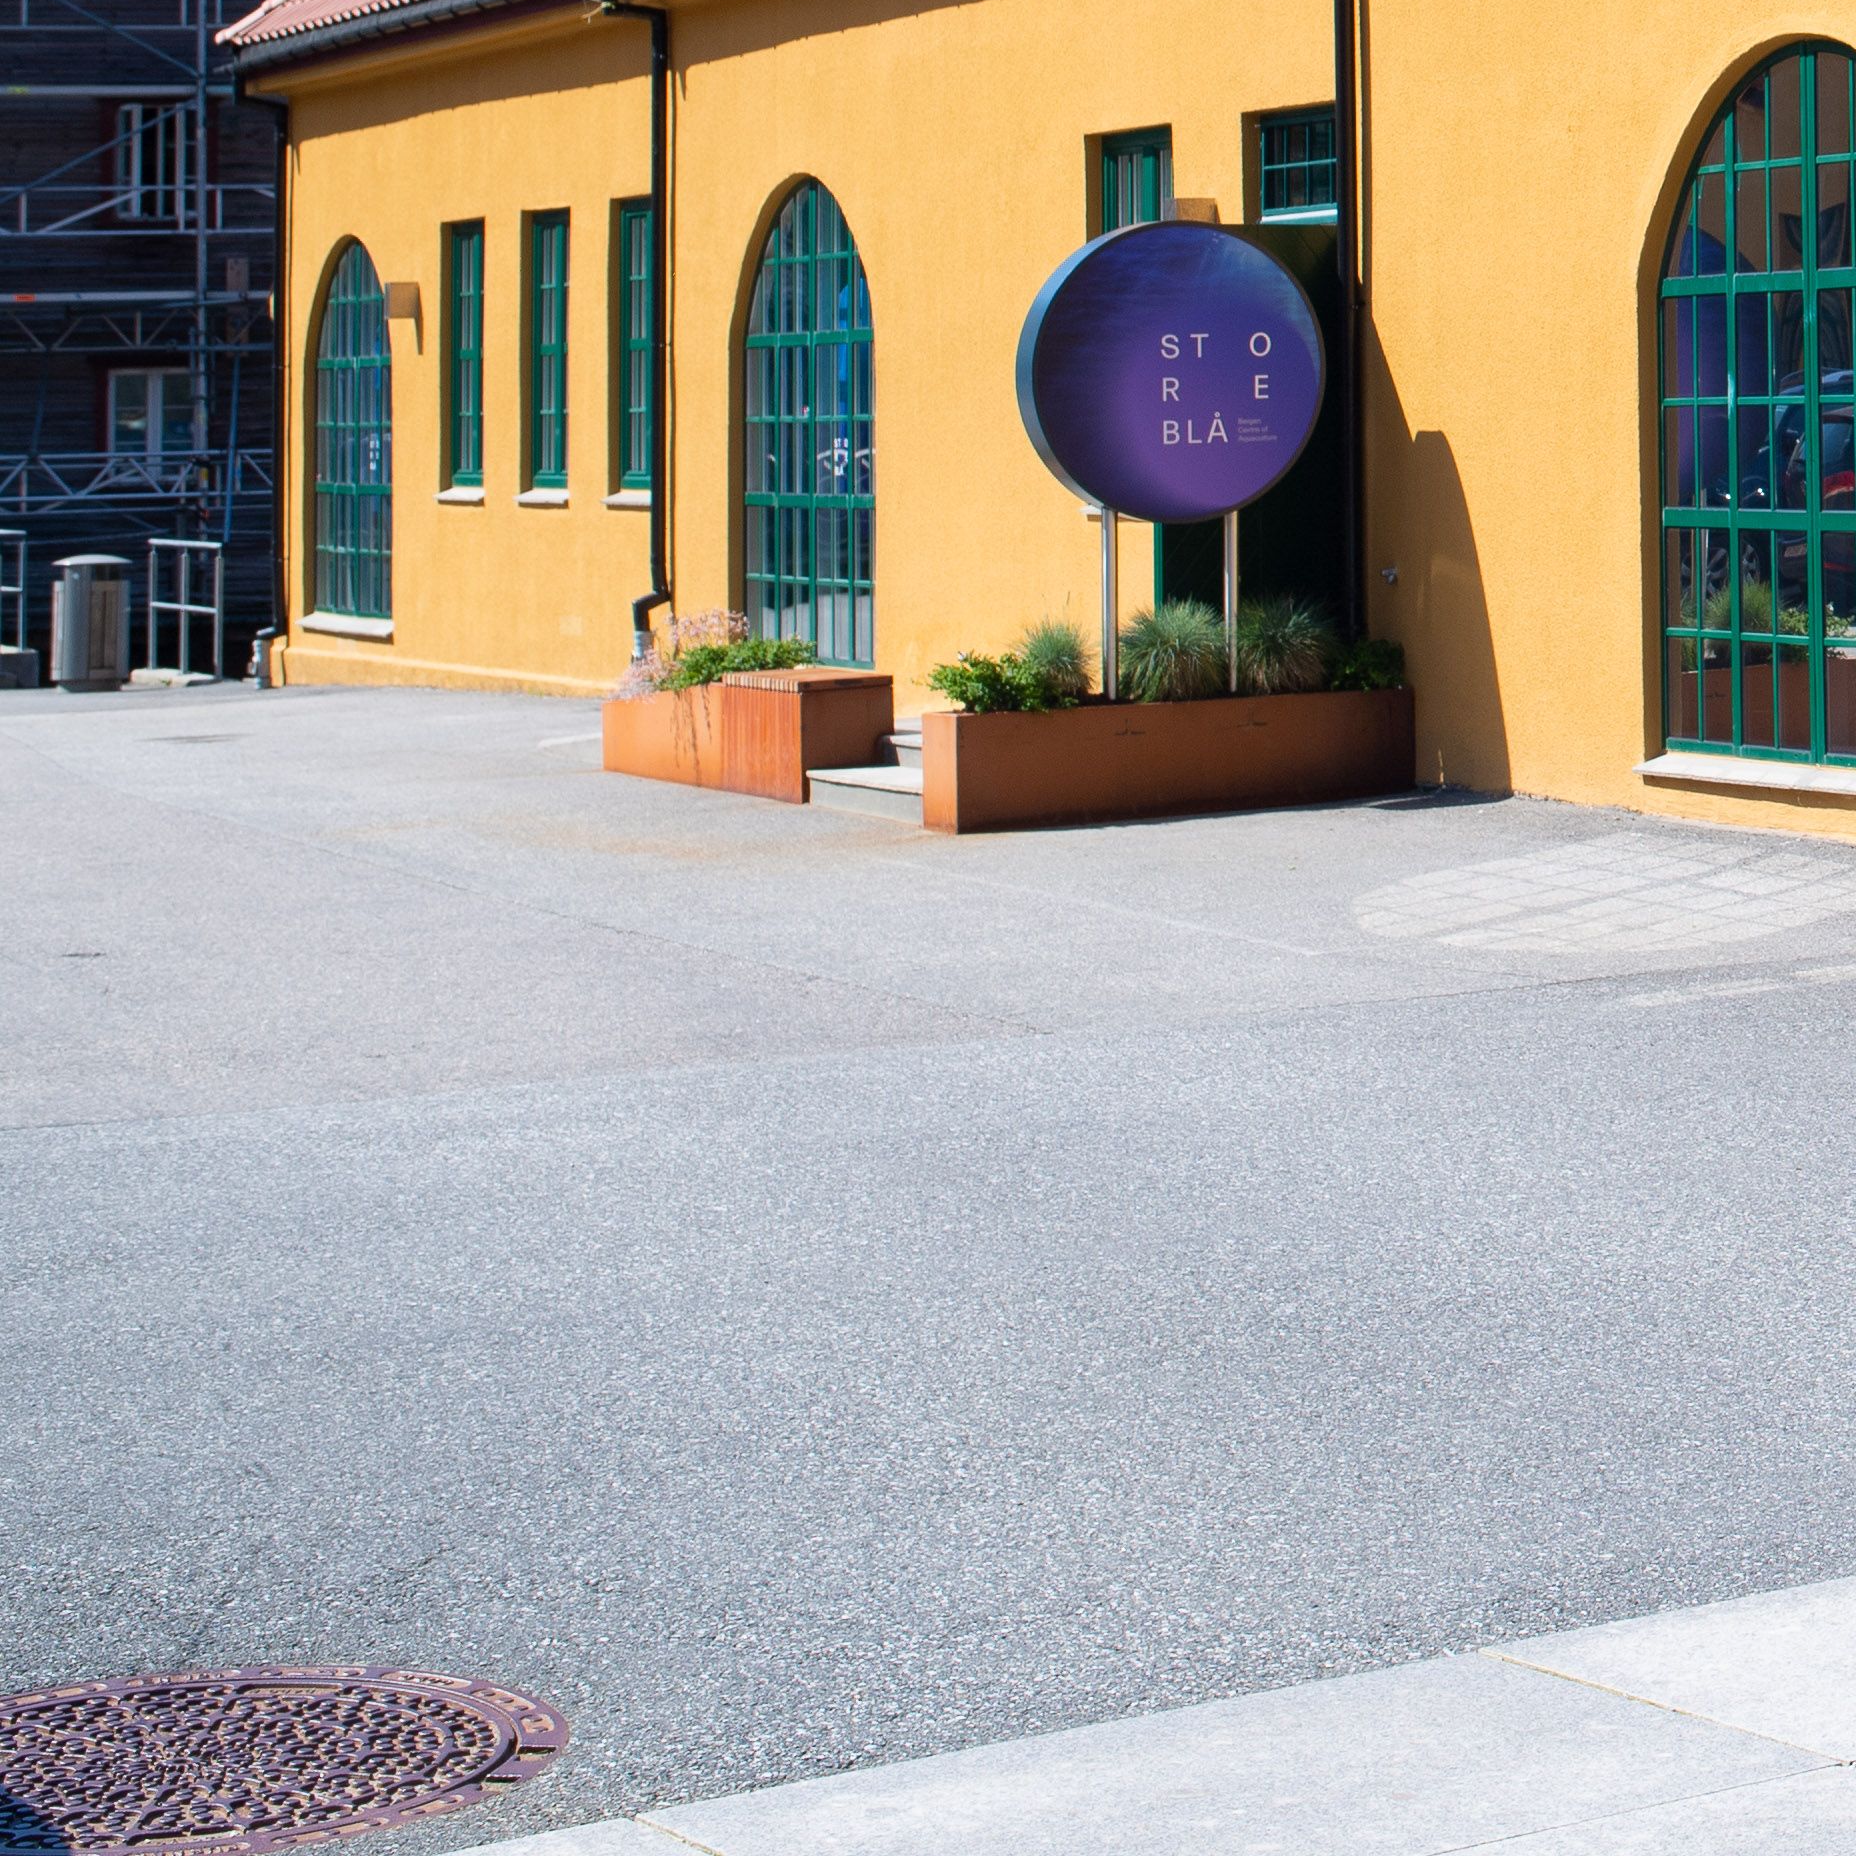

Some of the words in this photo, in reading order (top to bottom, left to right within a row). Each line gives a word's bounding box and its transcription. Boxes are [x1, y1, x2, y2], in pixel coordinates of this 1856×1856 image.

[1162, 377, 1180, 402] R
[1254, 374, 1269, 399] E
[1163, 411, 1228, 444] BLÅ
